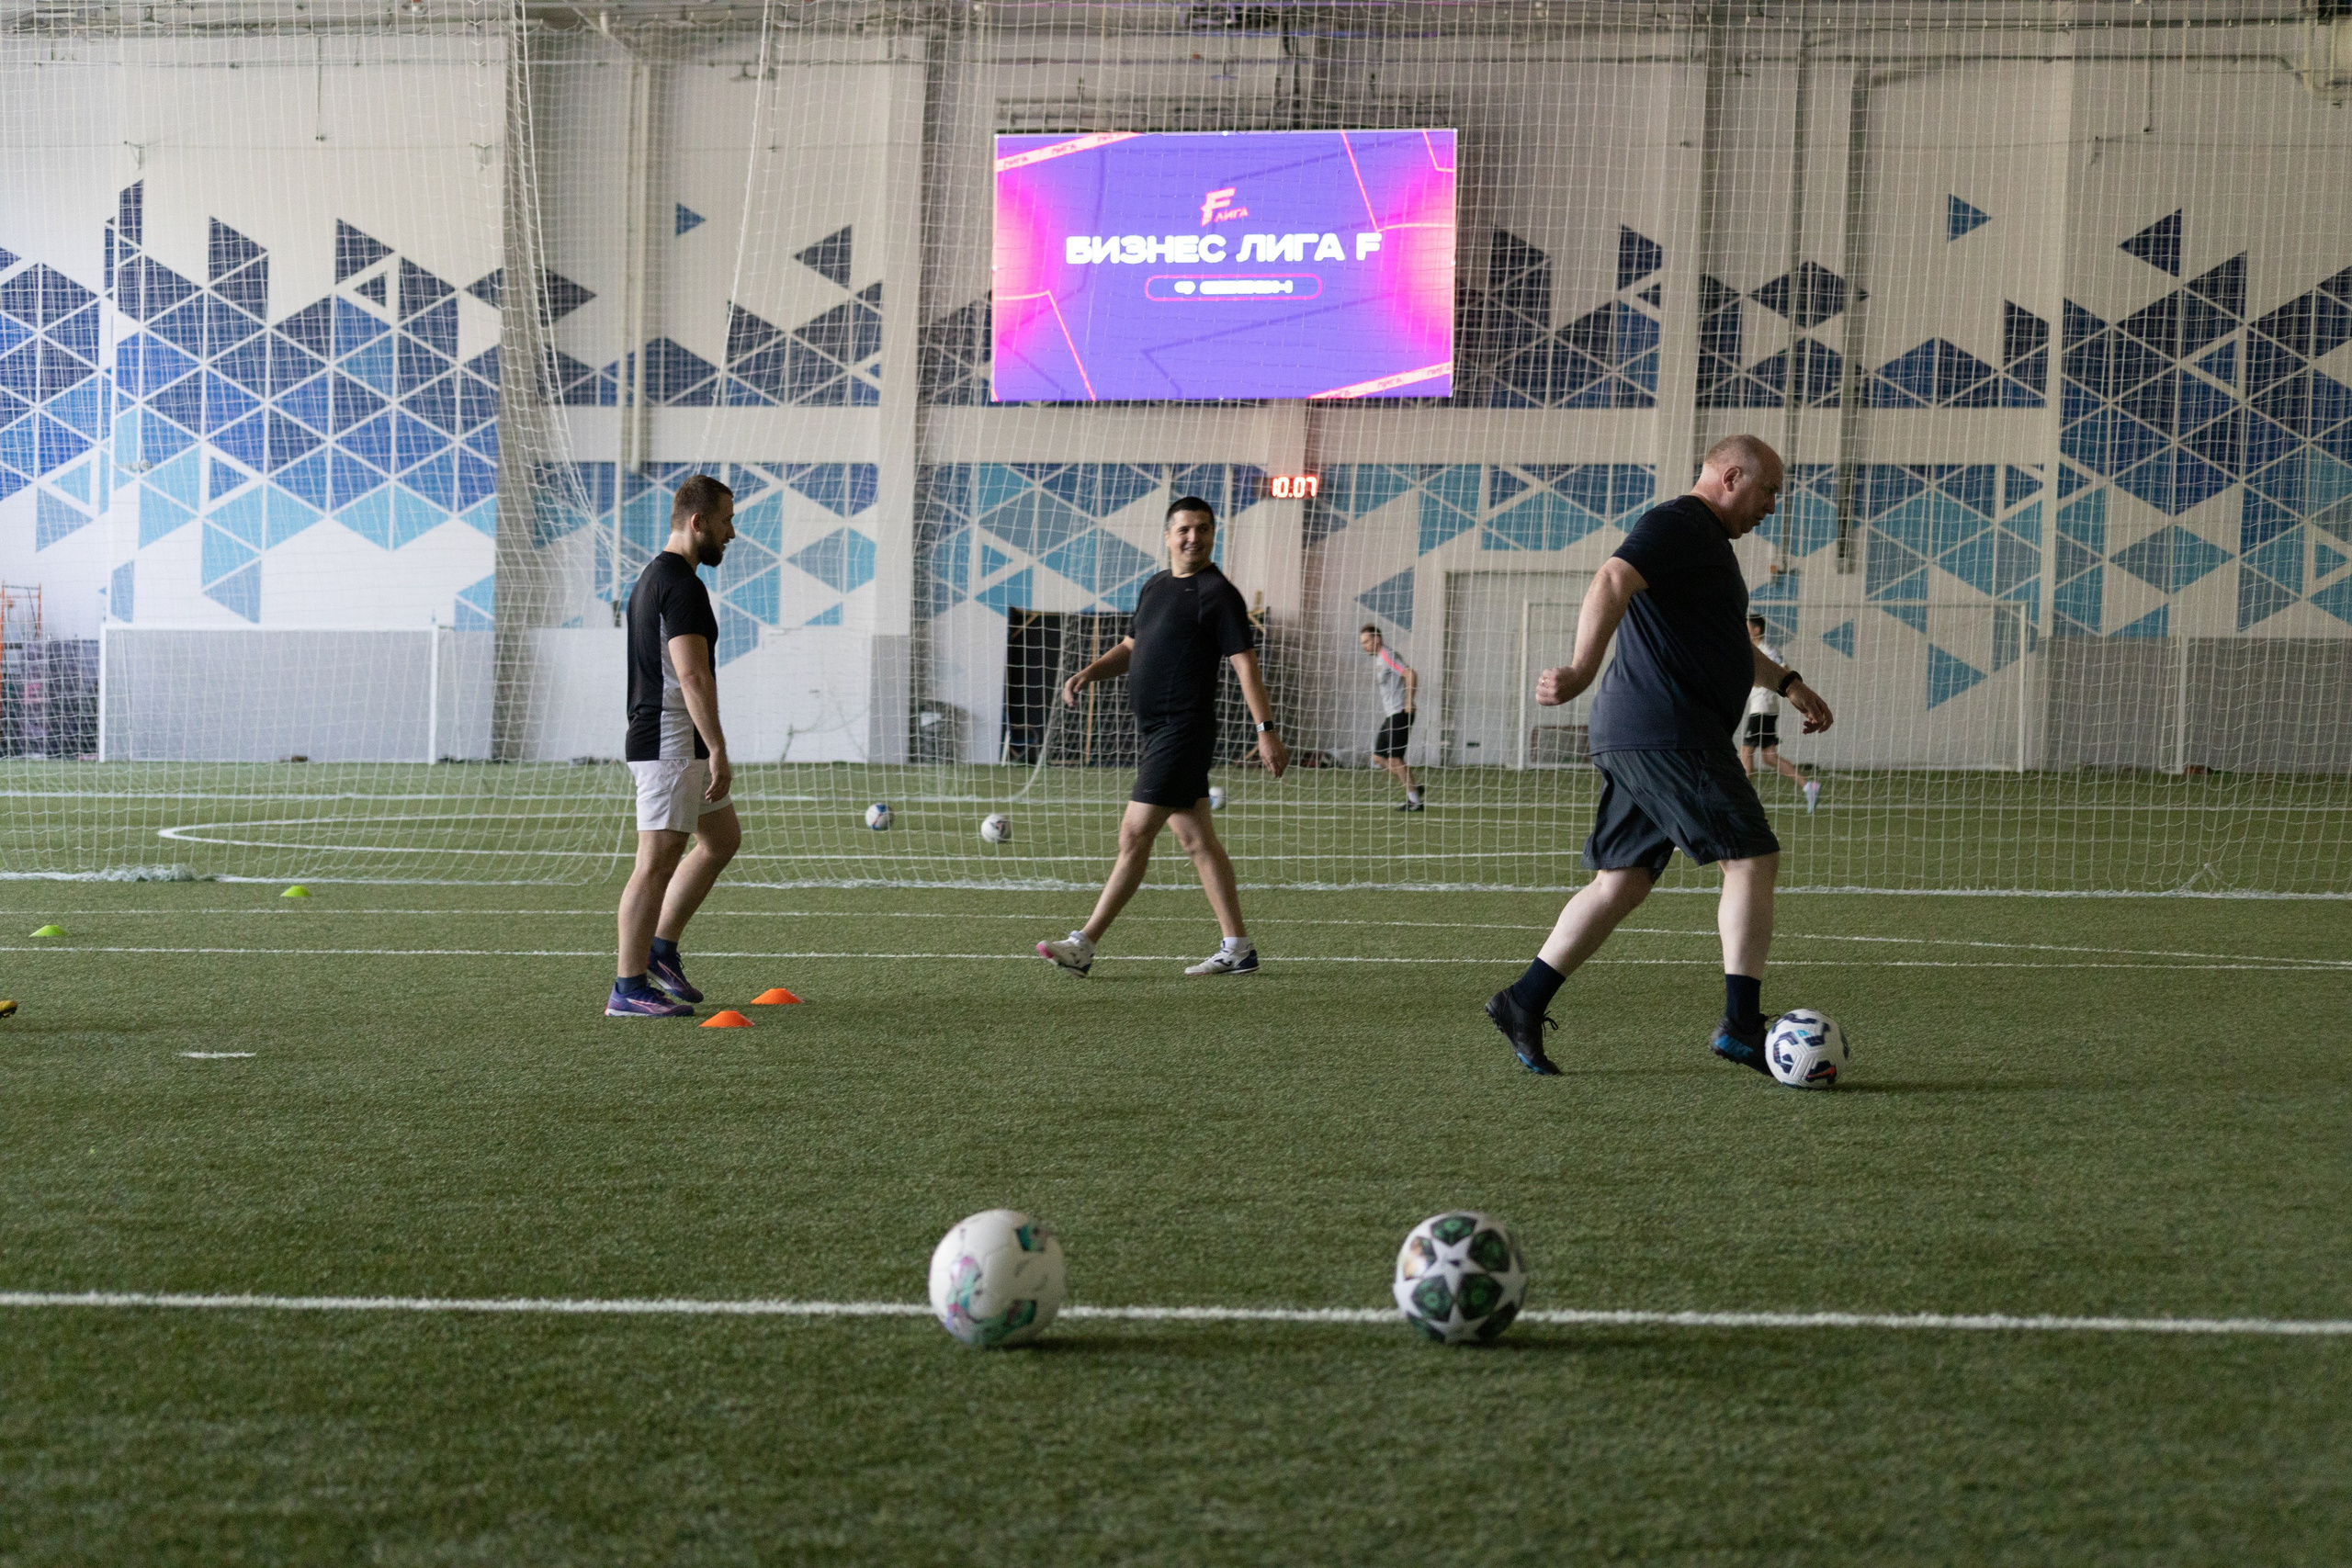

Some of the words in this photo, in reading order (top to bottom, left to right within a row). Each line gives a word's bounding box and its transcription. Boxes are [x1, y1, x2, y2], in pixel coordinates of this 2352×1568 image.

[1199, 186, 1237, 227] F
[1214, 206, 1250, 223] ЛИГА
[1066, 234, 1227, 265] БИЗНЕС
[1236, 232, 1346, 263] ЛИГА
[1355, 232, 1383, 262] F
